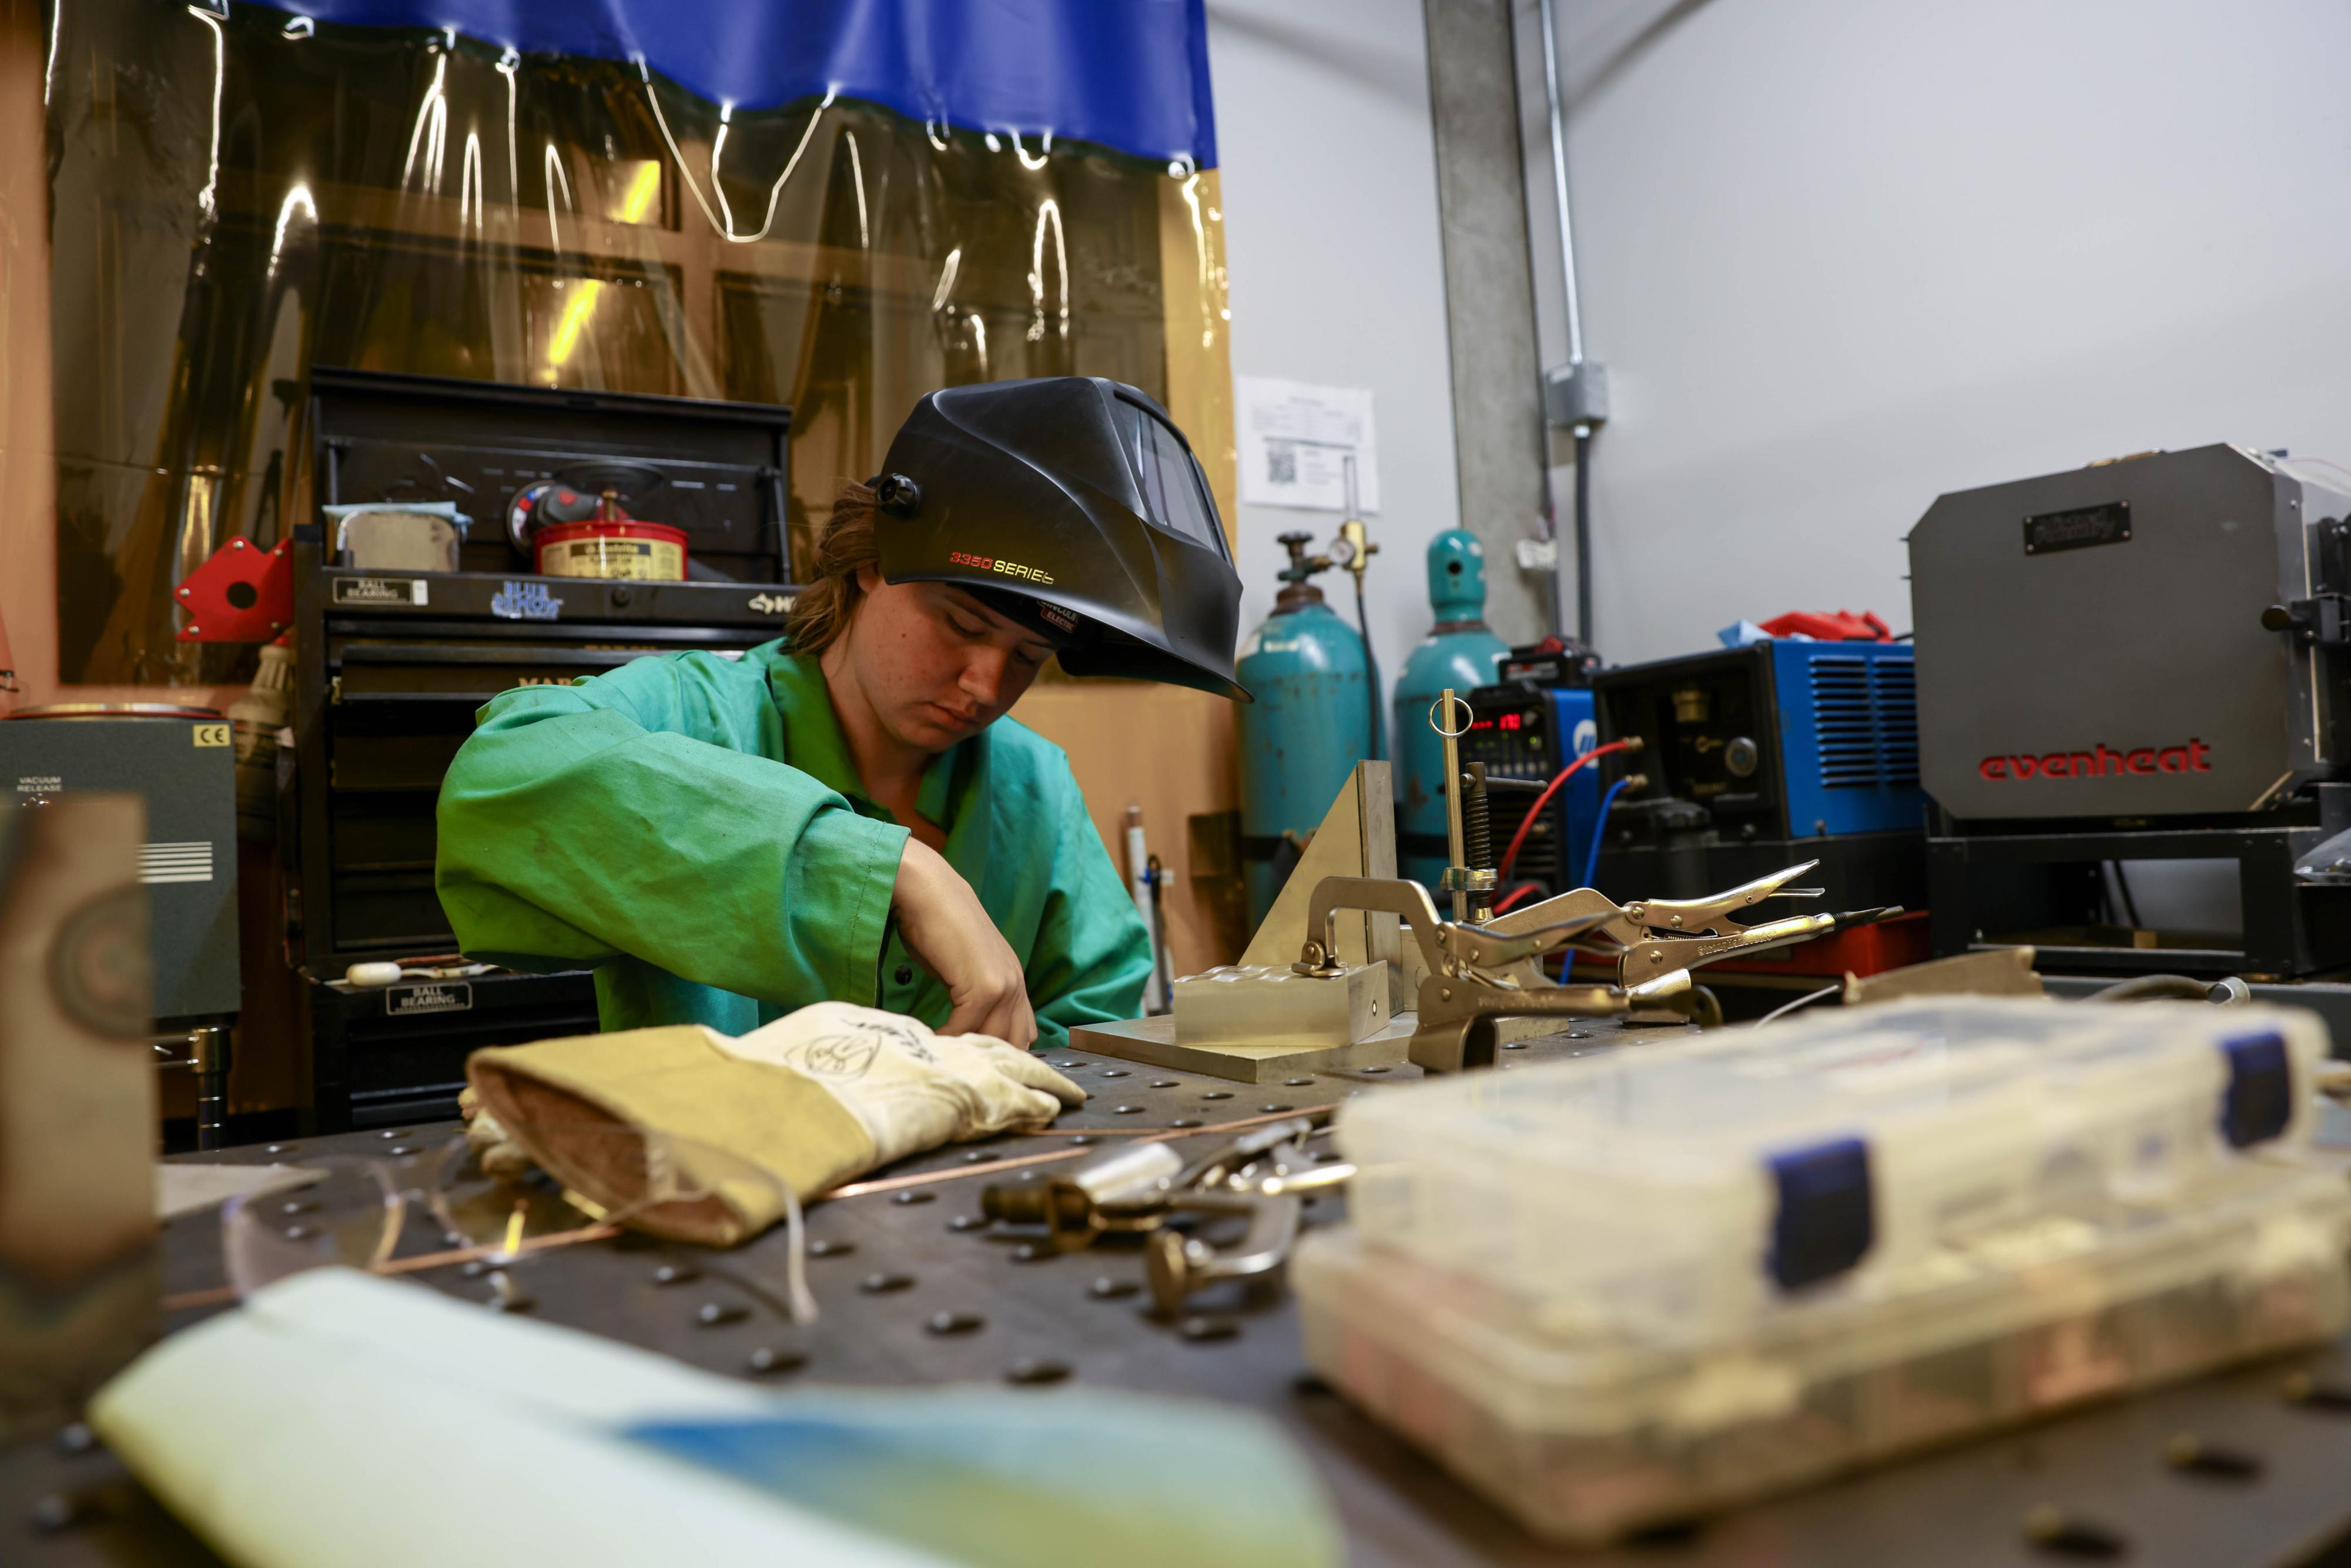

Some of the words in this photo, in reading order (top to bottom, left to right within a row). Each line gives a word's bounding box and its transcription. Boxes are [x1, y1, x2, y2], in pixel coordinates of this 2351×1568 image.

[949, 551, 993, 569] 3350
[1979, 737, 2212, 781] evenheat
[413, 987, 443, 997] BALL
[401, 994, 456, 1007] BEARING
